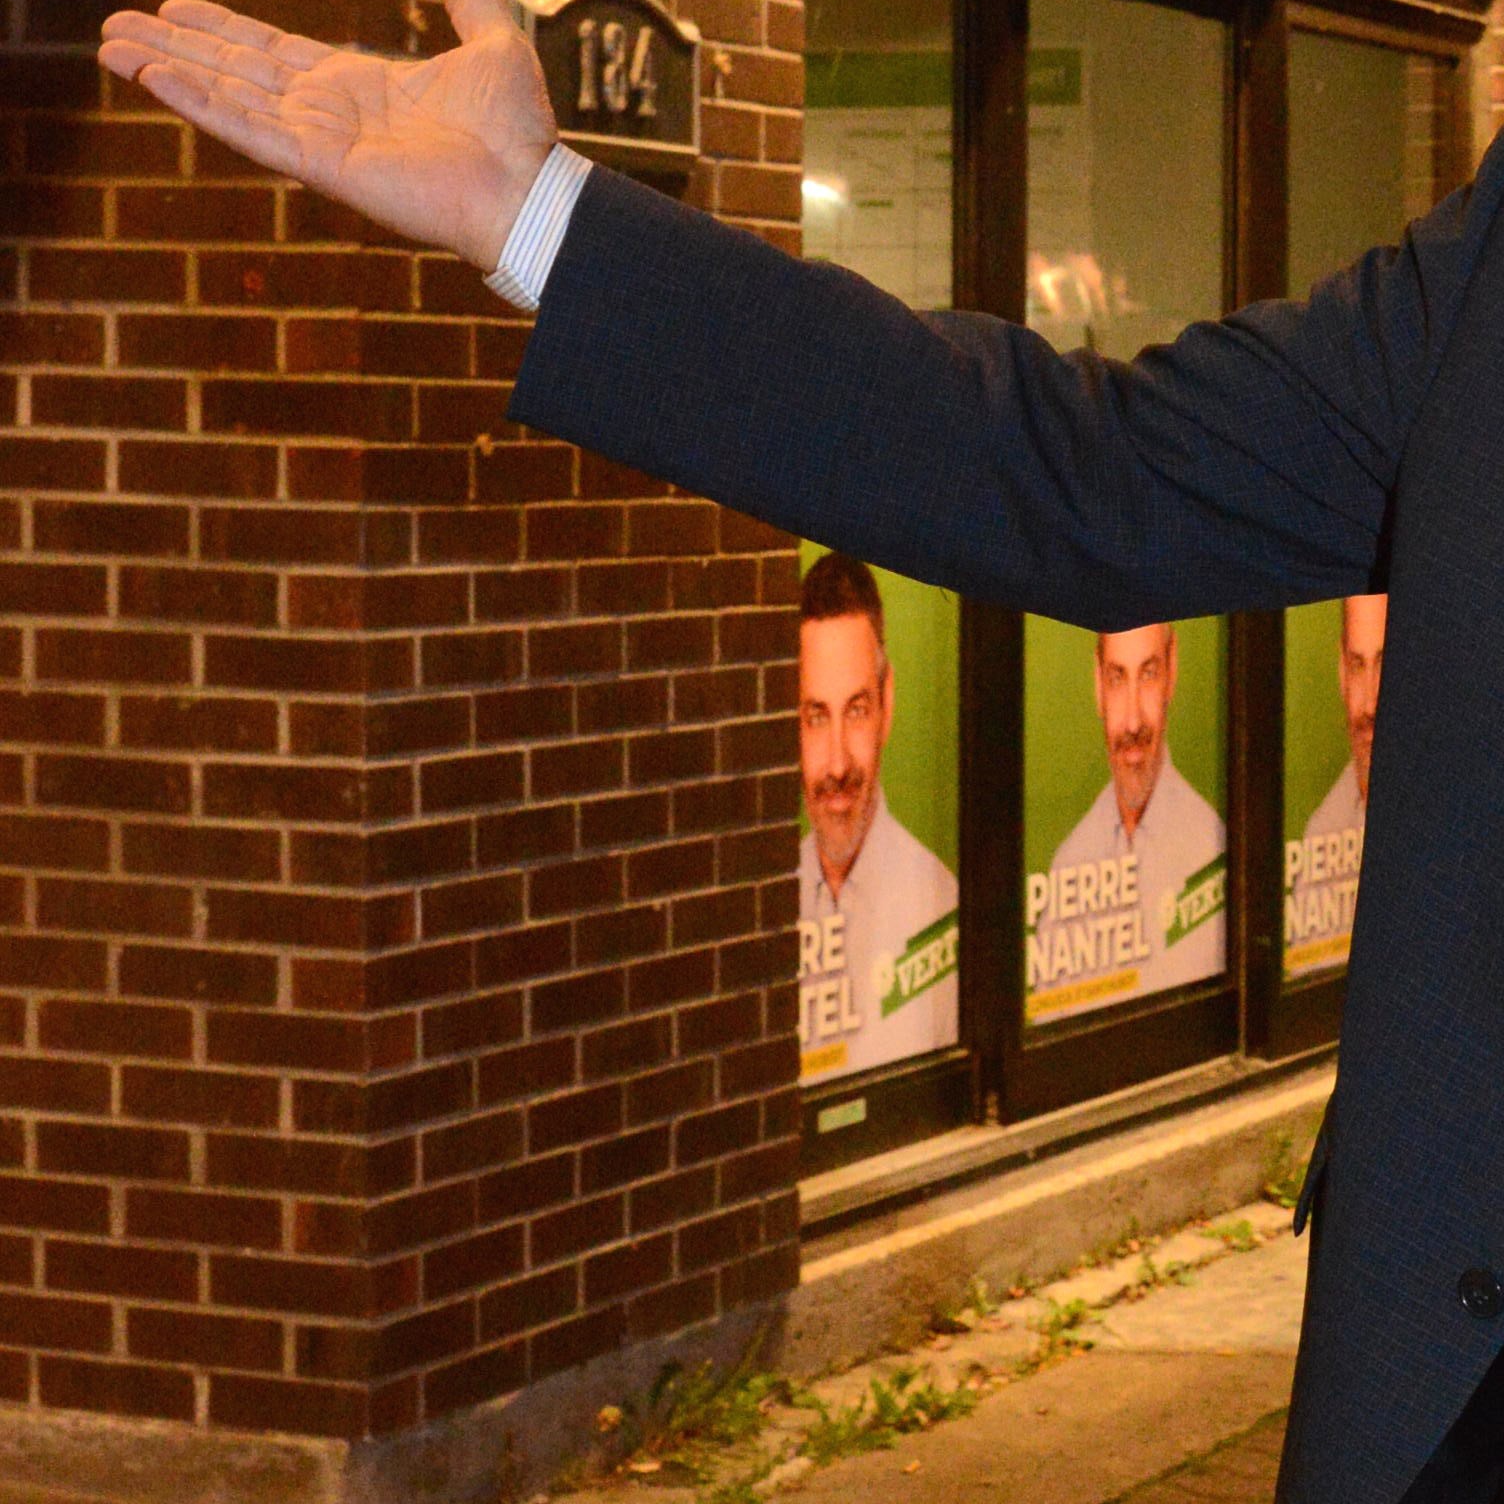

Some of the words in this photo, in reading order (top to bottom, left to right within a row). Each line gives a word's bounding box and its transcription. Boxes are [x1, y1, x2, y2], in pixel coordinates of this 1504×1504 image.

[1026, 854, 1140, 927] PIERRE
[1285, 825, 1364, 888] PIERR
[1026, 911, 1150, 986] NANTEL
